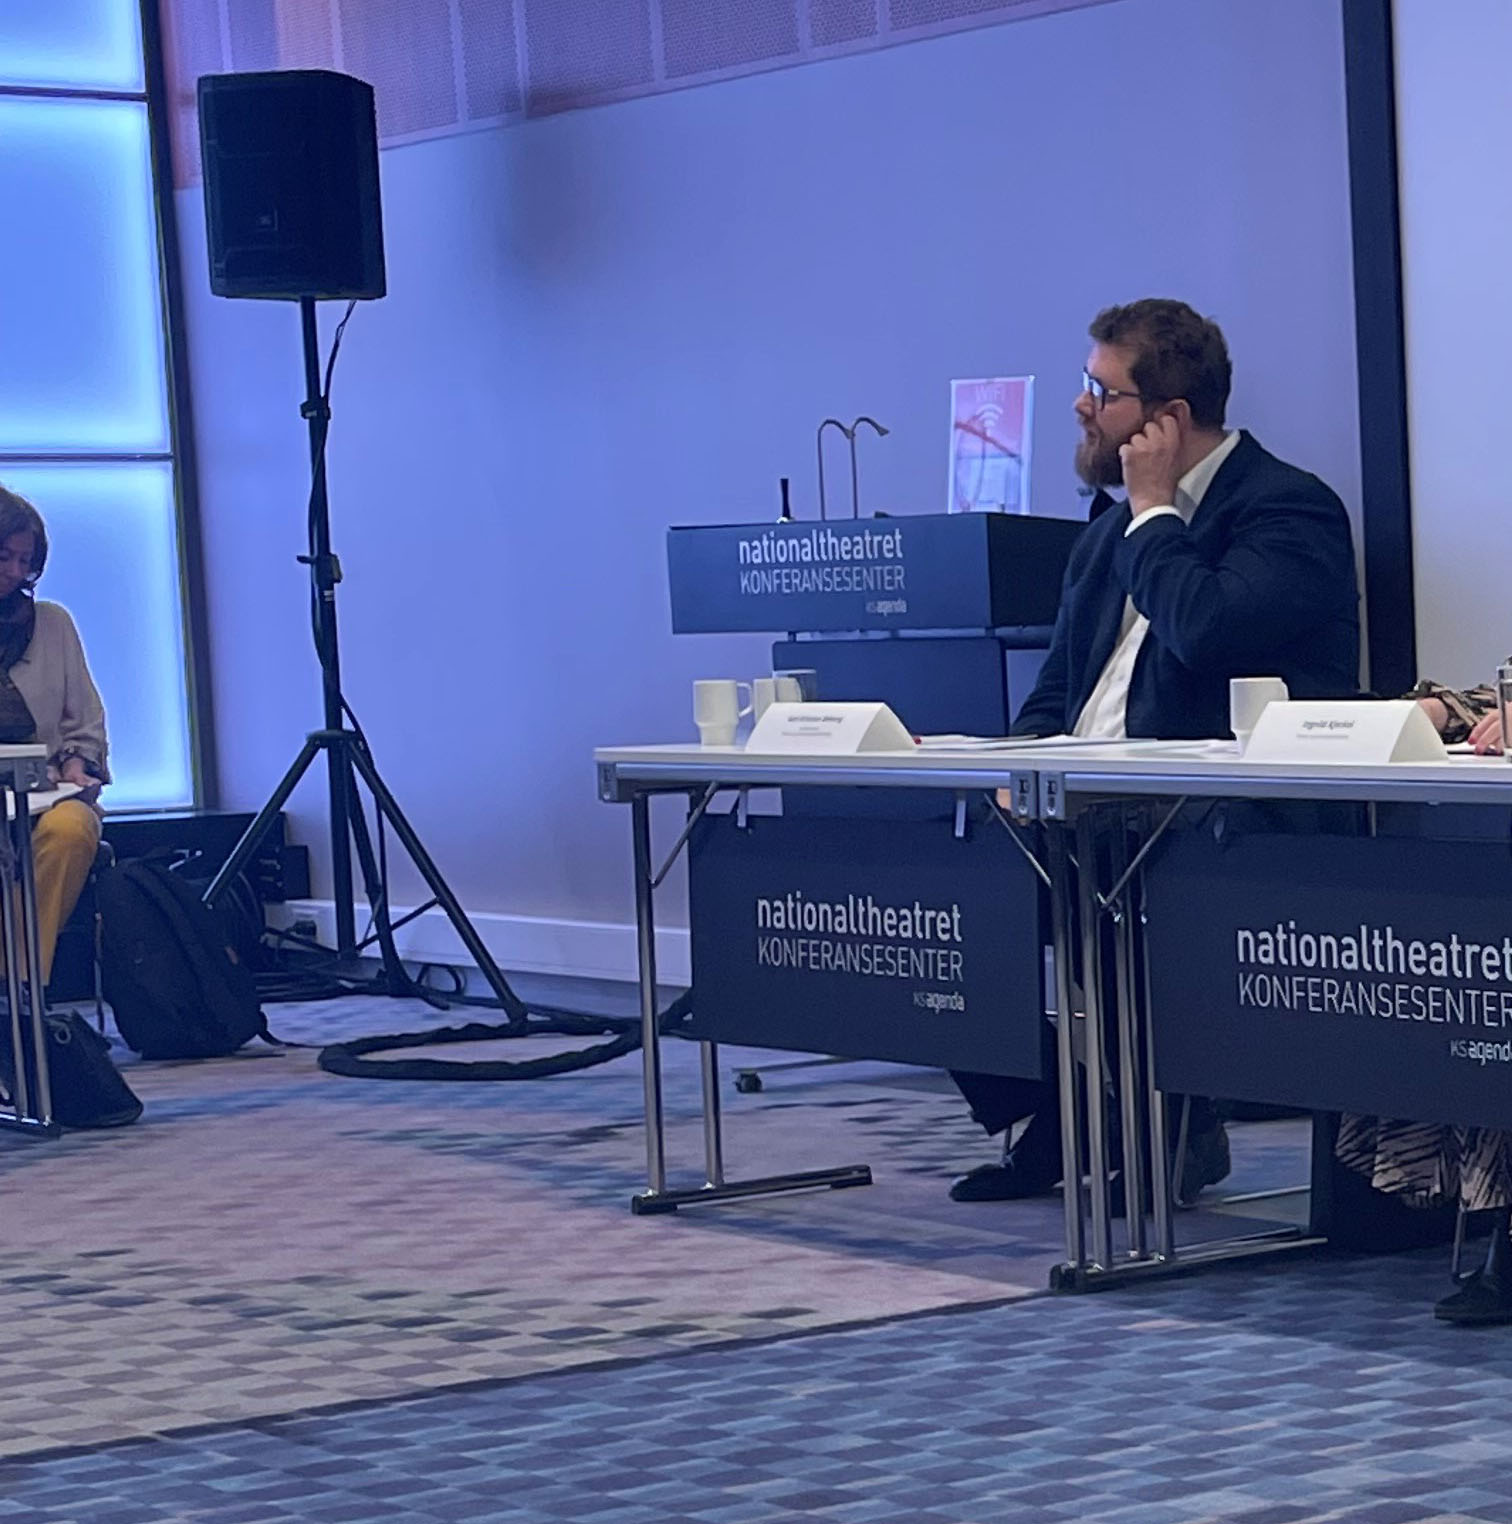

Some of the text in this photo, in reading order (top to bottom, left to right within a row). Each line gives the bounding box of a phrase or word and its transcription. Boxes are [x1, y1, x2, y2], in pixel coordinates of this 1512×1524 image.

[739, 527, 903, 564] nationaltheatret
[740, 565, 905, 594] KONFERANSESENTER
[757, 890, 962, 942] nationaltheatret
[758, 936, 963, 982] KONFERANSESENTER
